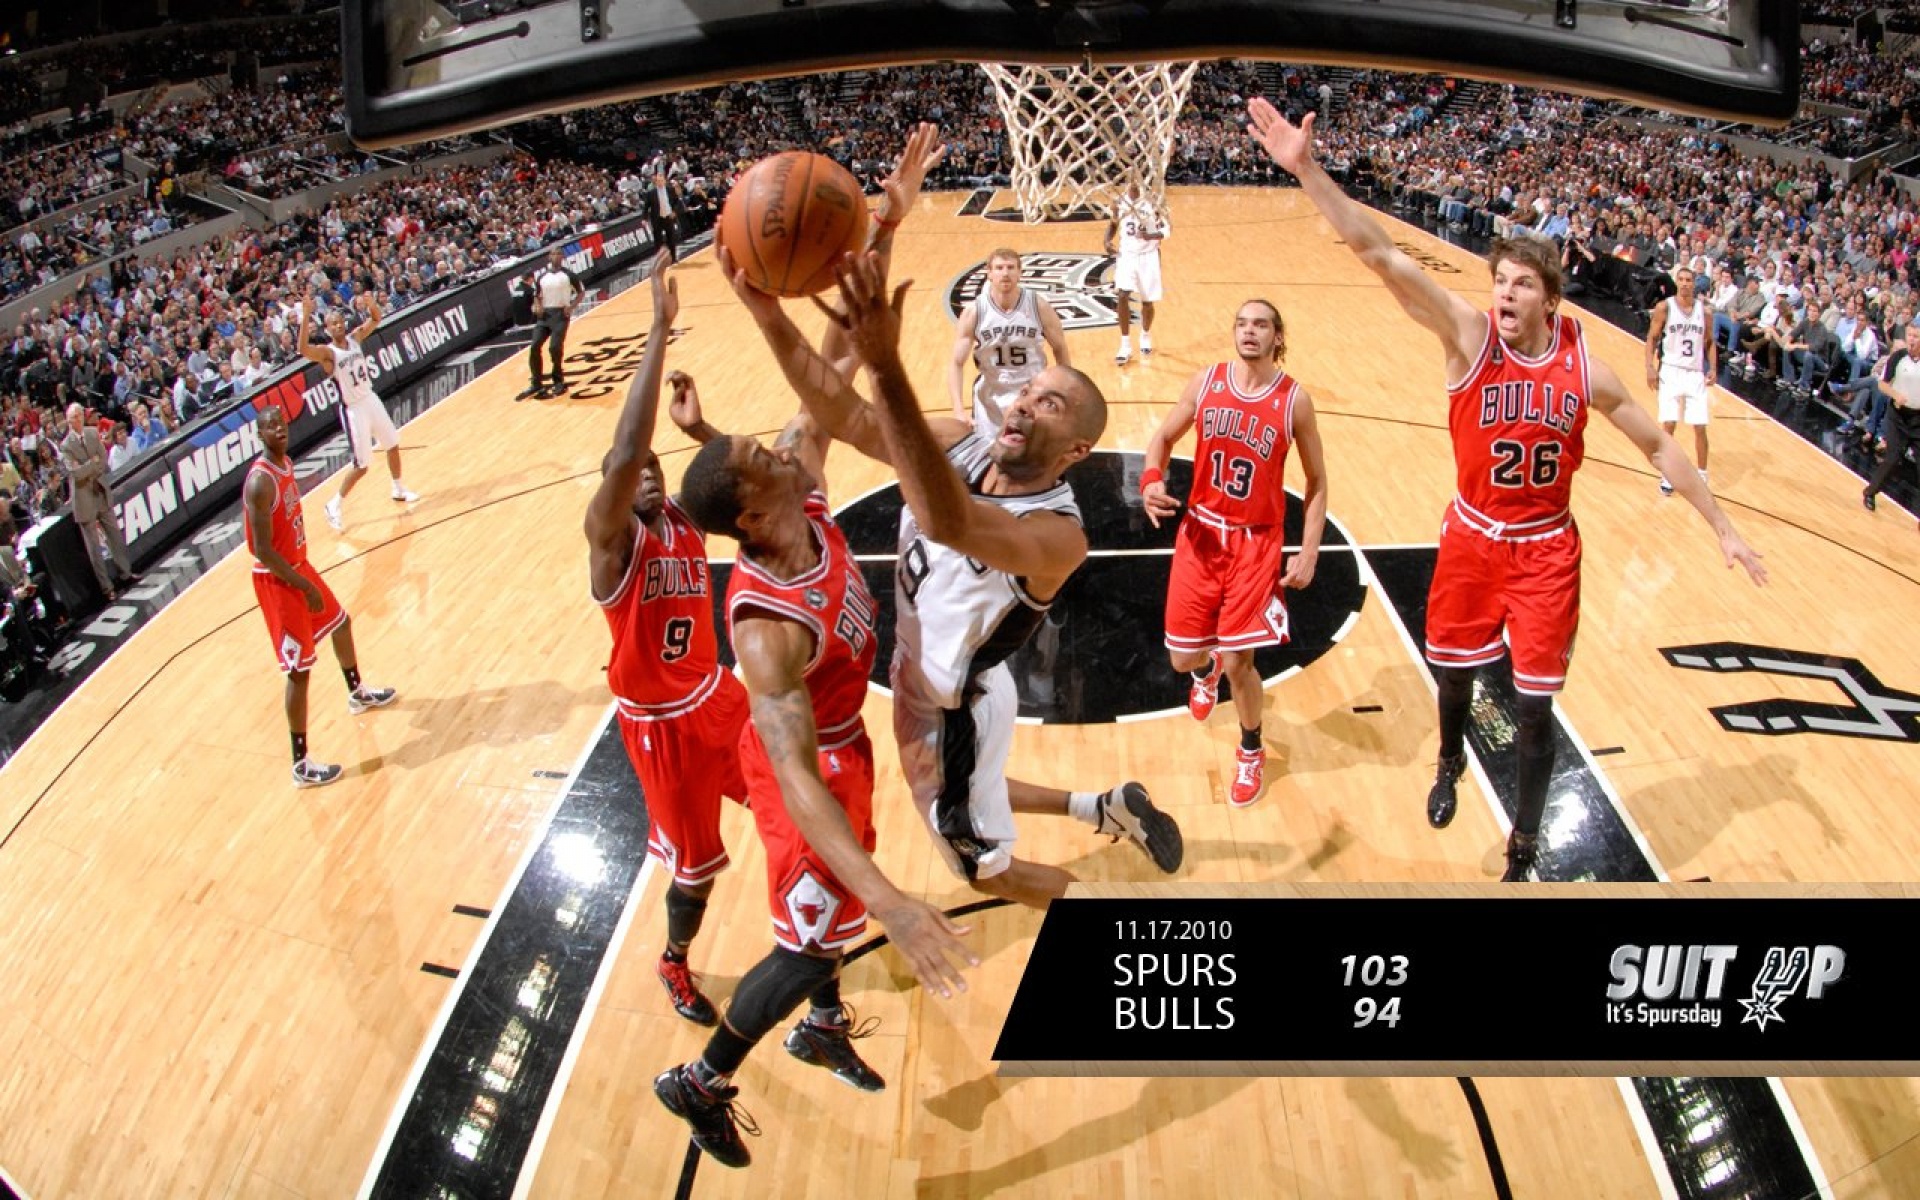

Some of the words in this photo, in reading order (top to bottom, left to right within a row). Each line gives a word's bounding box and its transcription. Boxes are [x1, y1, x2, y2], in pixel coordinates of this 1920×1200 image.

[761, 156, 796, 240] SPALDIN
[981, 325, 1037, 341] SPURS
[994, 344, 1027, 367] 15
[1682, 339, 1694, 357] 3
[350, 365, 367, 386] 14
[177, 418, 265, 502] NIGH
[378, 342, 404, 372] ON
[413, 315, 452, 355] NBA
[443, 303, 469, 337] TV
[1478, 380, 1580, 436] BULLS
[1202, 407, 1278, 461] BULLS
[1211, 450, 1255, 500] 13
[1490, 437, 1564, 489] 26
[660, 614, 695, 663] 9
